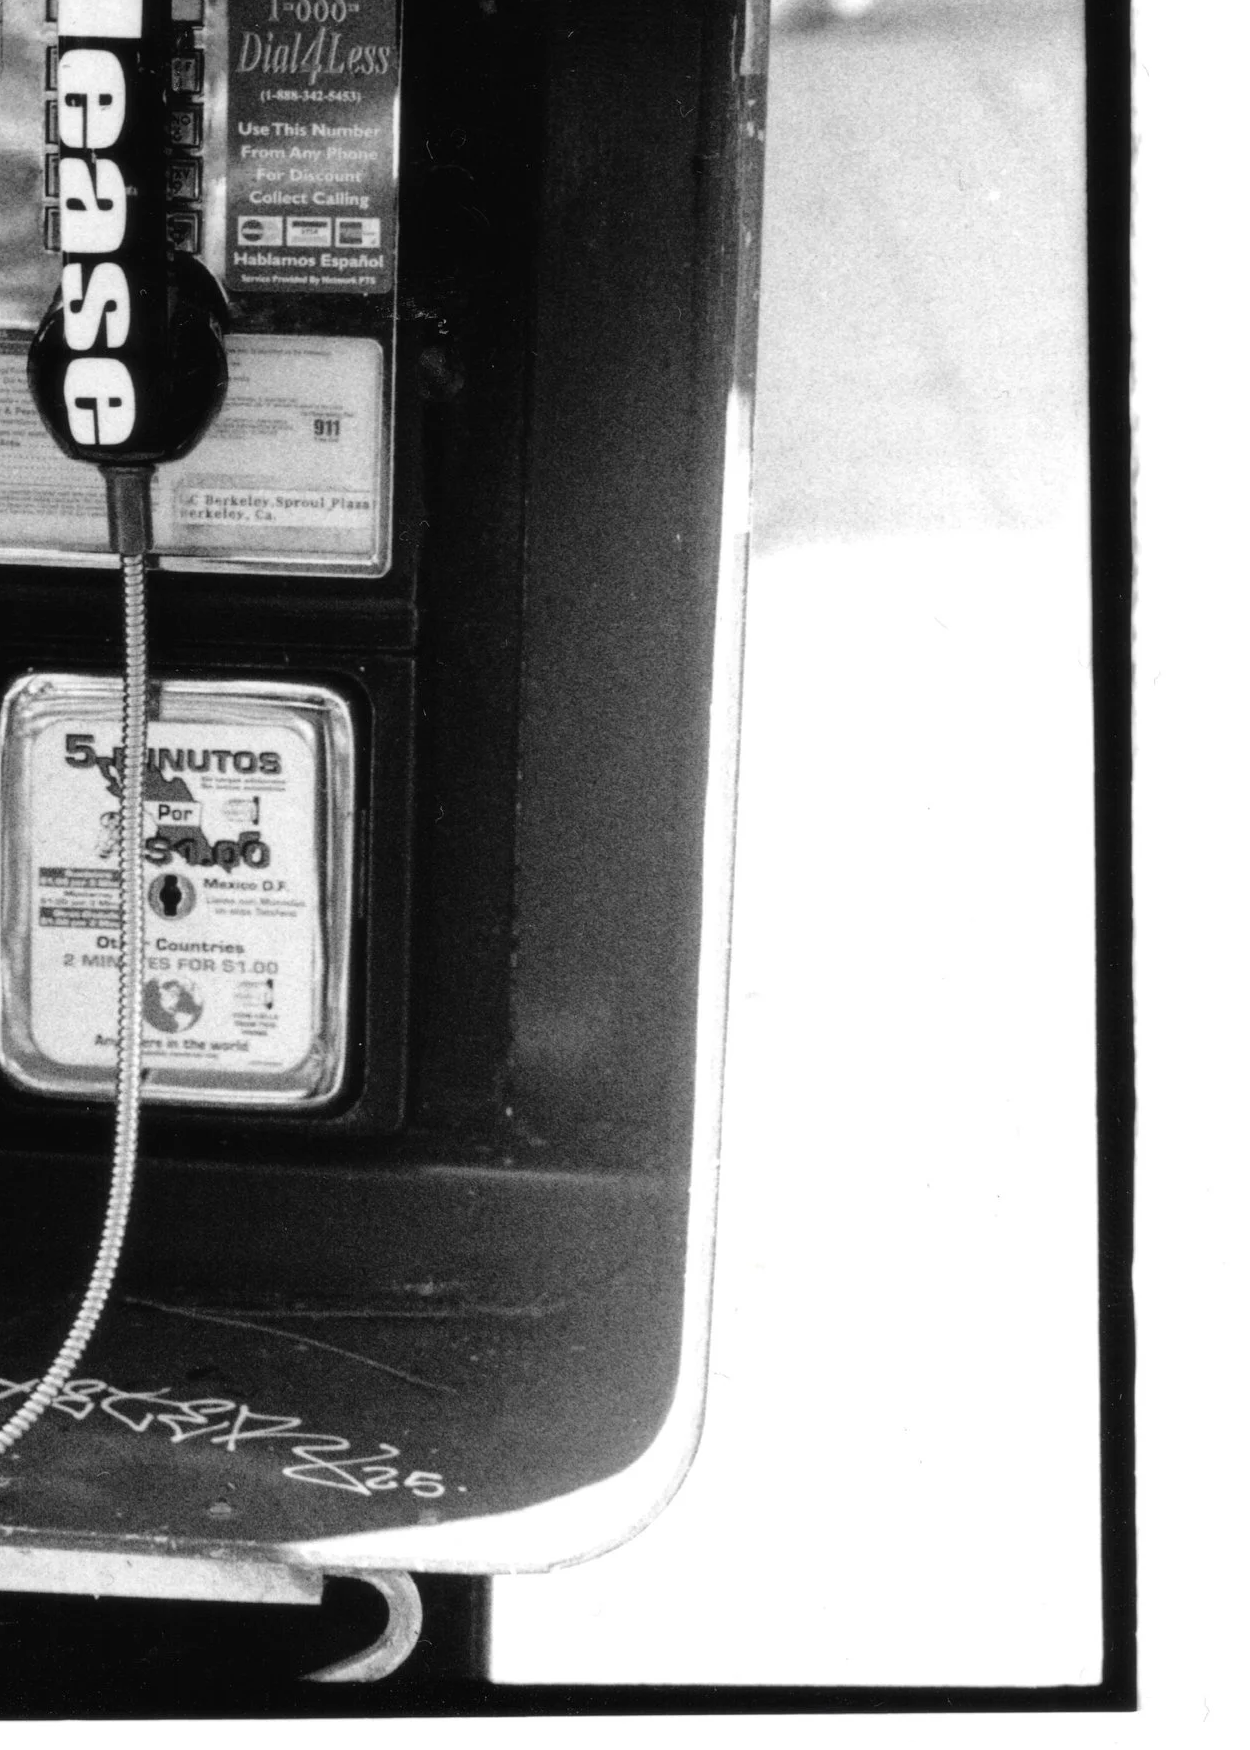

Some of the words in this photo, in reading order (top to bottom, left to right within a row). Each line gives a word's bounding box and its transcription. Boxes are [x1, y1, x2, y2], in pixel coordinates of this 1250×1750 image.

[235, 26, 392, 86] Dial4Less
[238, 122, 270, 136] Use
[272, 122, 307, 137] This
[311, 123, 381, 138] Number
[241, 145, 286, 159] From
[289, 147, 321, 161] Any
[327, 147, 379, 161] Phone
[257, 168, 285, 181] For
[290, 169, 363, 183] Discount
[249, 190, 309, 205] Collect
[313, 192, 370, 210] Calling
[233, 252, 316, 267] Hablamos
[320, 253, 384, 271] Español
[358, 276, 376, 286] PTS
[313, 418, 341, 436] 911
[64, 733, 95, 769] 5
[158, 803, 193, 822] Por
[203, 878, 258, 891] Mexico
[156, 937, 246, 954] Countries
[63, 953, 75, 967] 2
[82, 954, 171, 971] MINES
[177, 958, 216, 972] FOR
[166, 1034, 178, 1048] in
[183, 1035, 206, 1050] the
[210, 1039, 249, 1052] world
